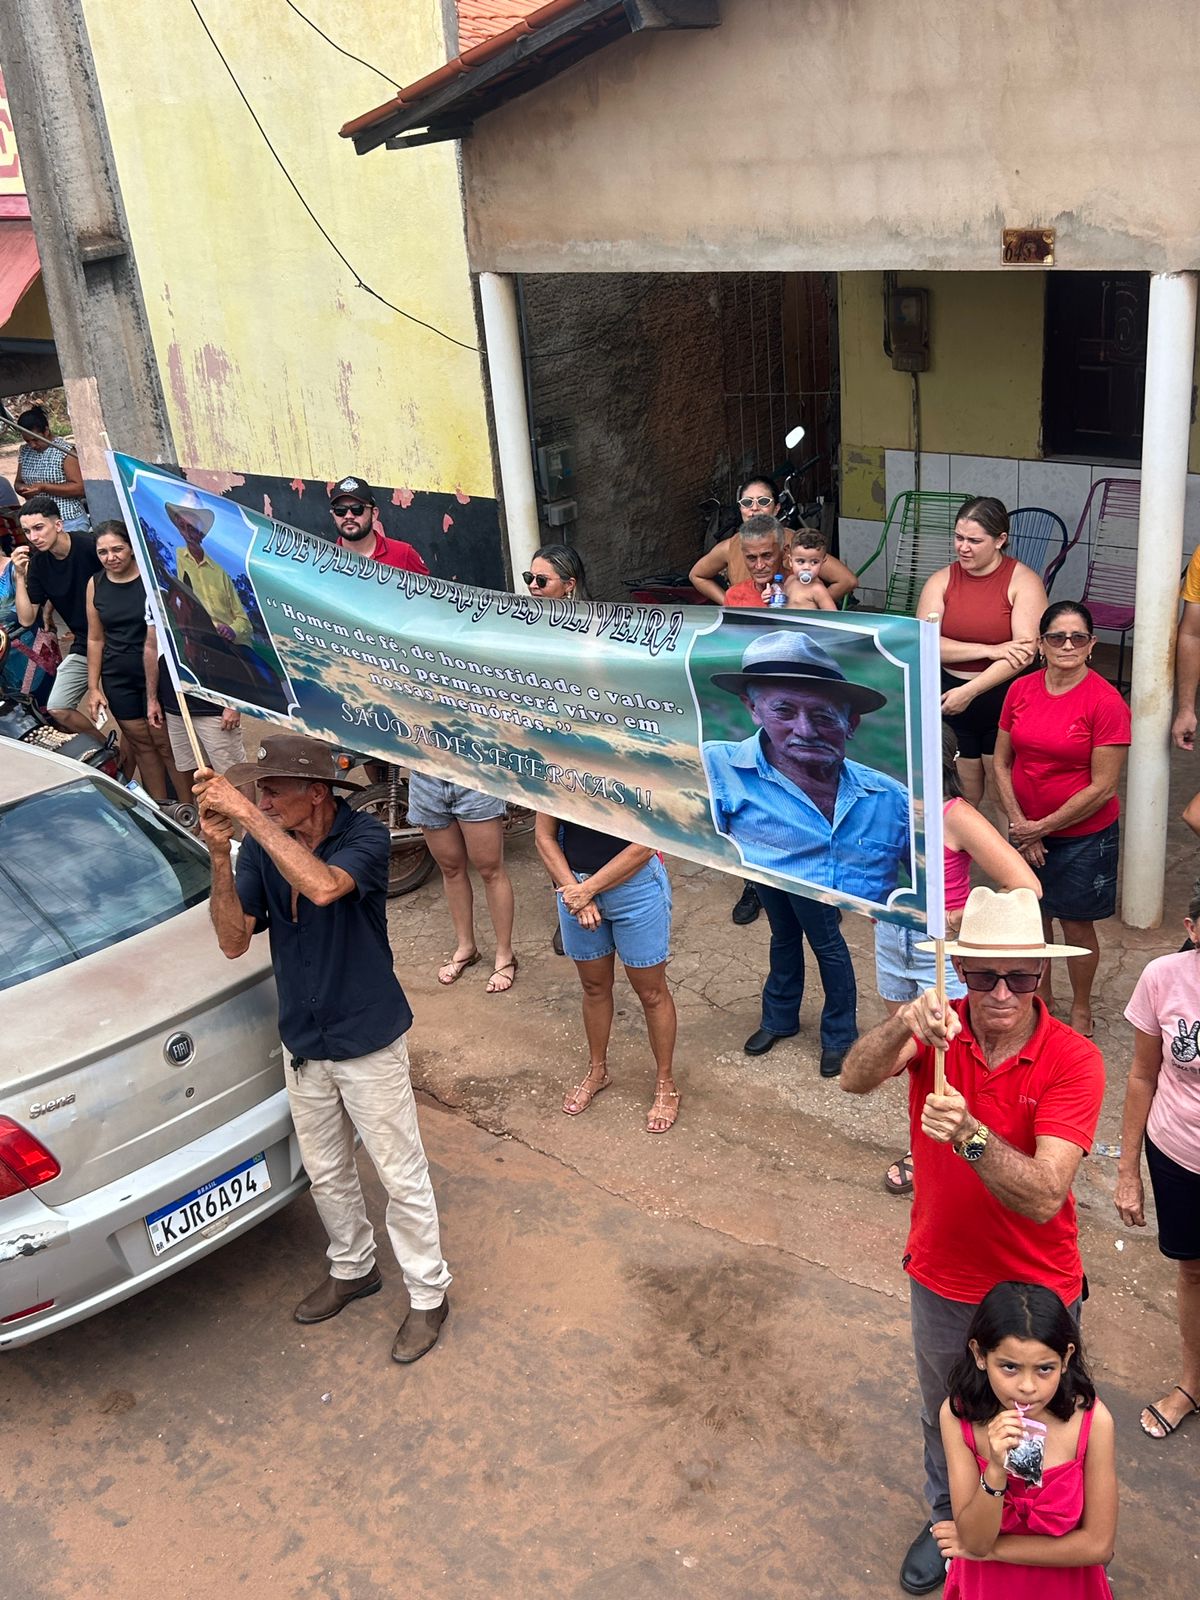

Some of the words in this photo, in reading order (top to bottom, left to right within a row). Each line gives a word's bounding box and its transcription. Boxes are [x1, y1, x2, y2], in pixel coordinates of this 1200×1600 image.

[263, 522, 394, 583] IDEVALDO
[549, 600, 684, 656] OLIVEIRA
[292, 626, 327, 649] Seu
[330, 642, 411, 675] exemplo
[414, 667, 560, 714] permanecerá
[563, 702, 618, 725] vivo
[624, 716, 661, 735] em
[353, 628, 376, 645] de
[378, 635, 407, 657] fé,
[410, 645, 436, 662] de
[439, 651, 582, 696] honestidade
[587, 687, 600, 700] e
[604, 690, 685, 715] valor.
[369, 672, 434, 701] nossas
[341, 702, 489, 763] SAUDADES
[489, 746, 626, 804] ETERNAS
[635, 787, 653, 811] !!
[173, 1040, 188, 1059] FIAT
[30, 1092, 76, 1119] Siena
[160, 1171, 257, 1243] KJR6A94
[197, 1181, 217, 1196] BRASIL
[155, 1241, 165, 1252] BR
